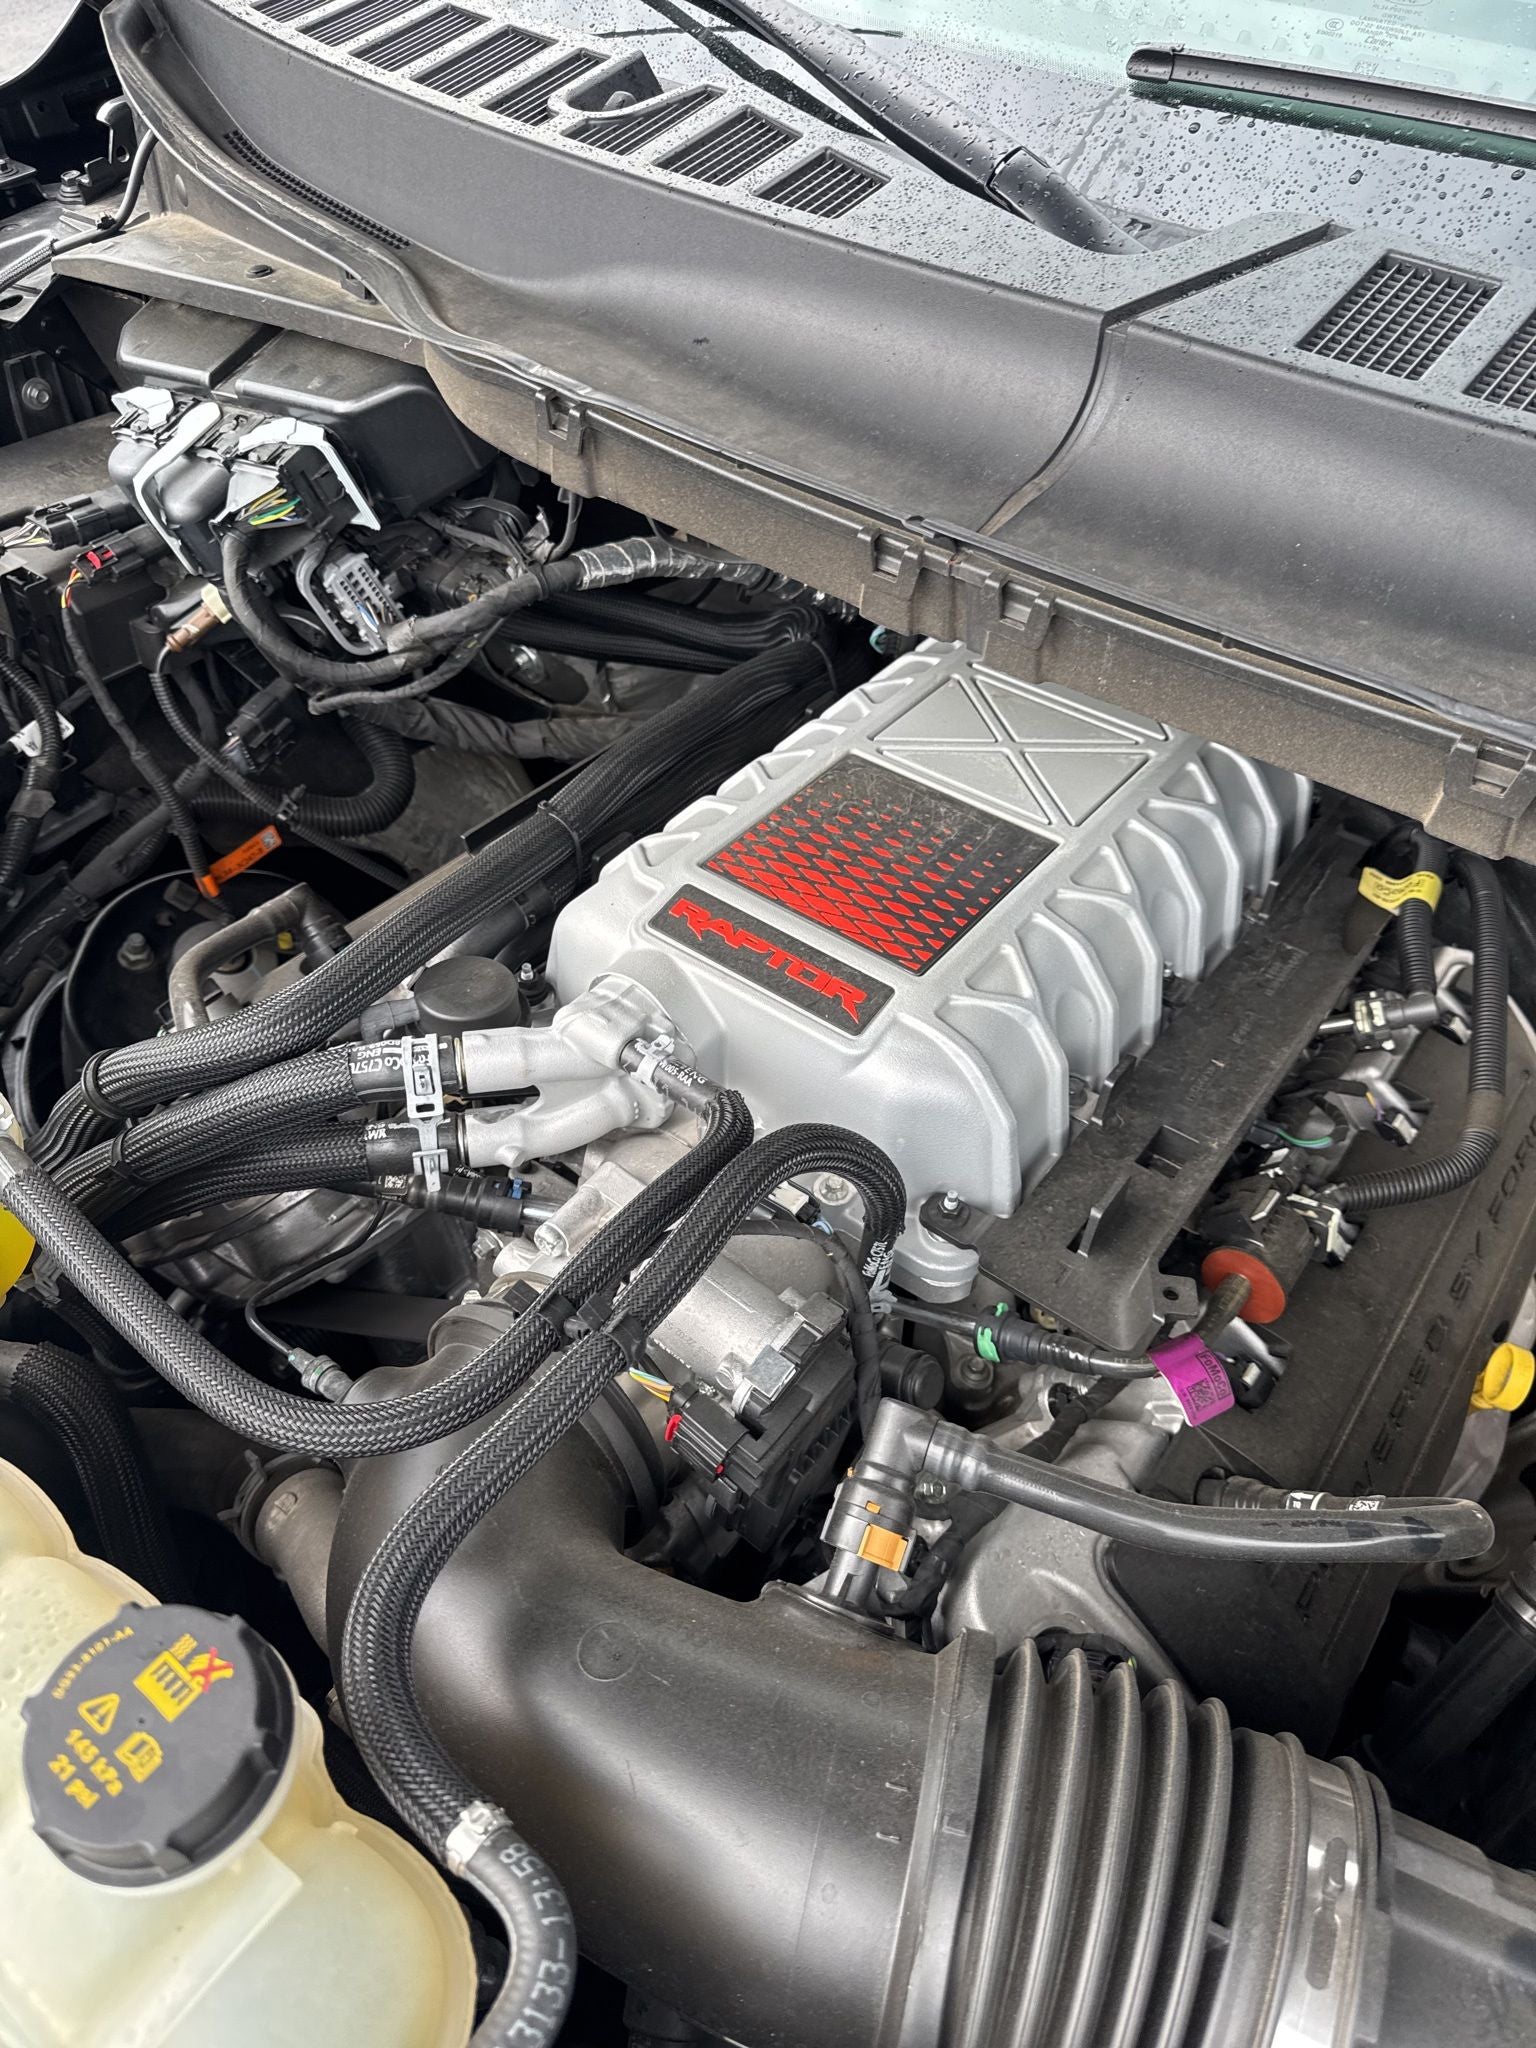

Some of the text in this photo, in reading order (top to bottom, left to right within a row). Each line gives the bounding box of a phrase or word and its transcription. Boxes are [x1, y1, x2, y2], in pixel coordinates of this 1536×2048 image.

[669, 898, 867, 1024] RAPTOR
[357, 1048, 382, 1060] ENG
[1201, 1352, 1228, 1399] FoMoCo
[48, 1753, 77, 1781] 21
